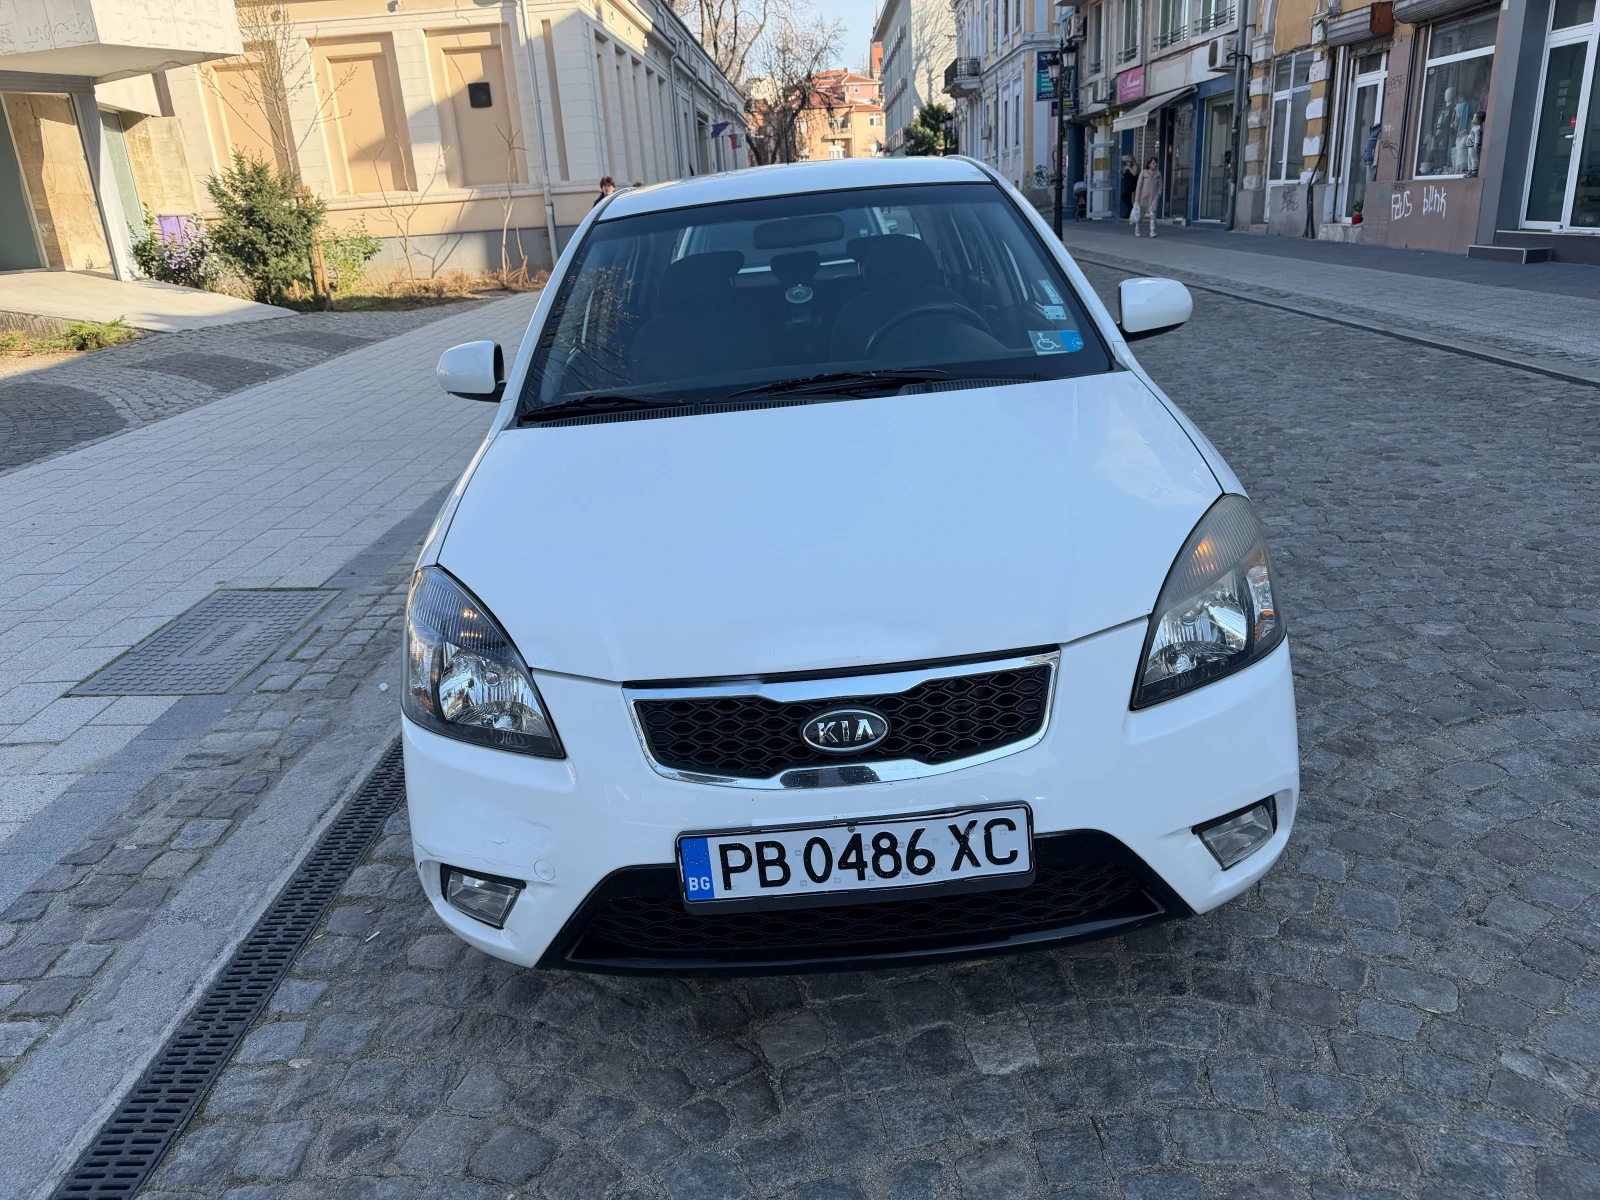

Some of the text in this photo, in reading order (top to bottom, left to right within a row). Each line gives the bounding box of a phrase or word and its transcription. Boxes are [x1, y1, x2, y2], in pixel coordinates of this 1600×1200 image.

[816, 718, 876, 744] KIA
[718, 817, 1019, 891] PB 0486 XC
[688, 876, 711, 891] BG
